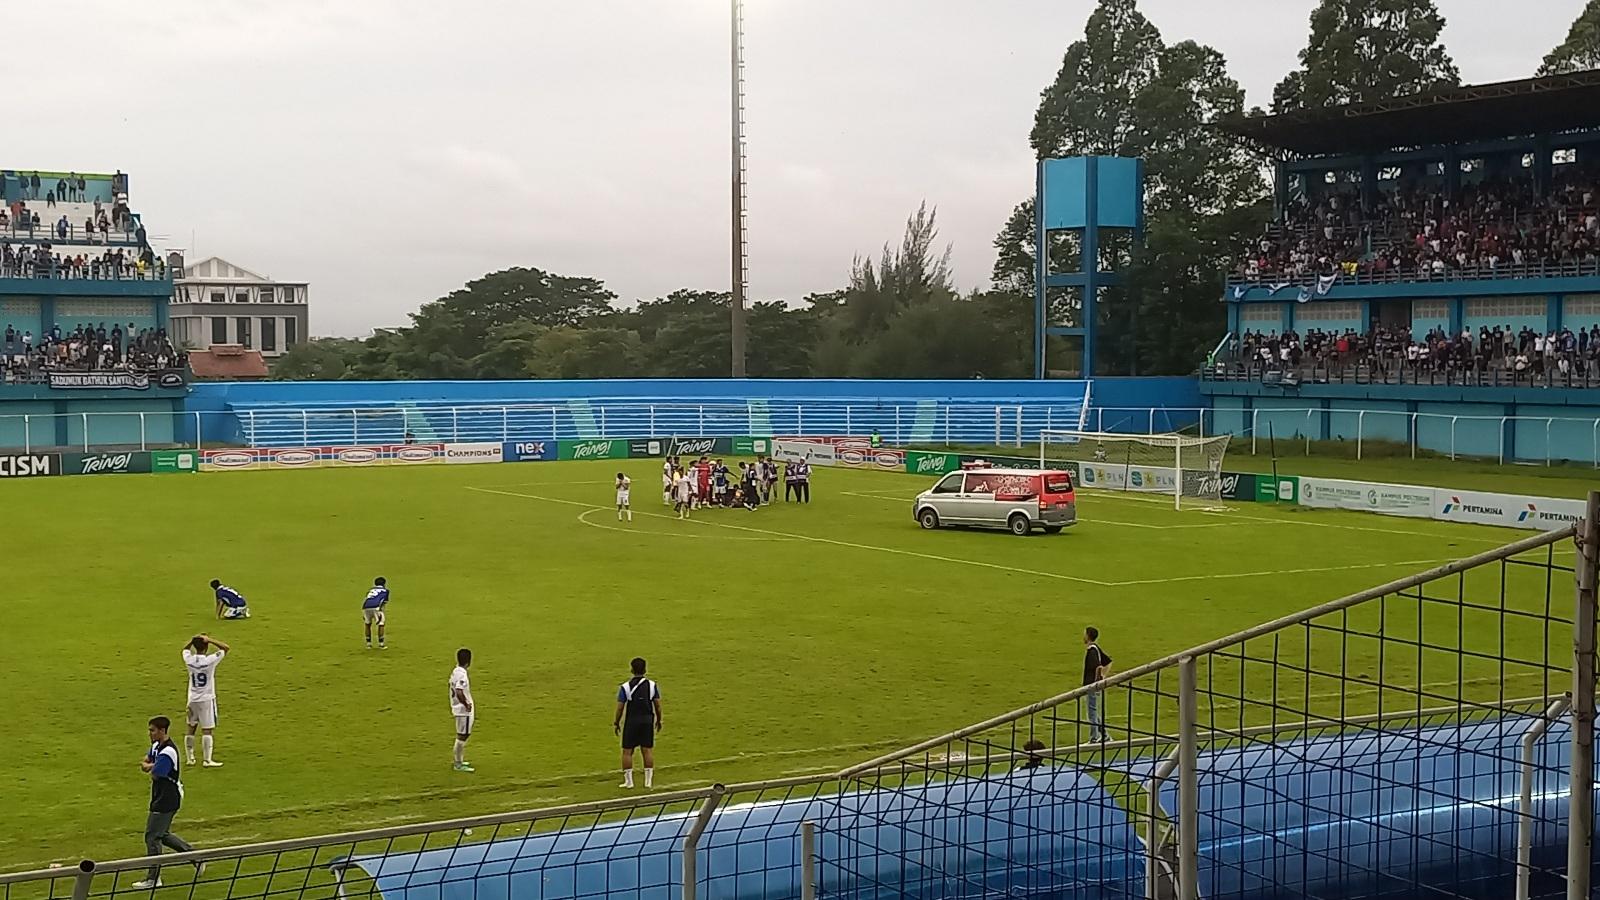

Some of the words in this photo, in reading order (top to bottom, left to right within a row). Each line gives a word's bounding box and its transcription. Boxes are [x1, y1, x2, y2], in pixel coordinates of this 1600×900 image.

[447, 449, 493, 458] CHAMPIONS
[515, 442, 545, 454] nex
[1462, 504, 1503, 516] PERTAMINA
[191, 672, 208, 688] 19
